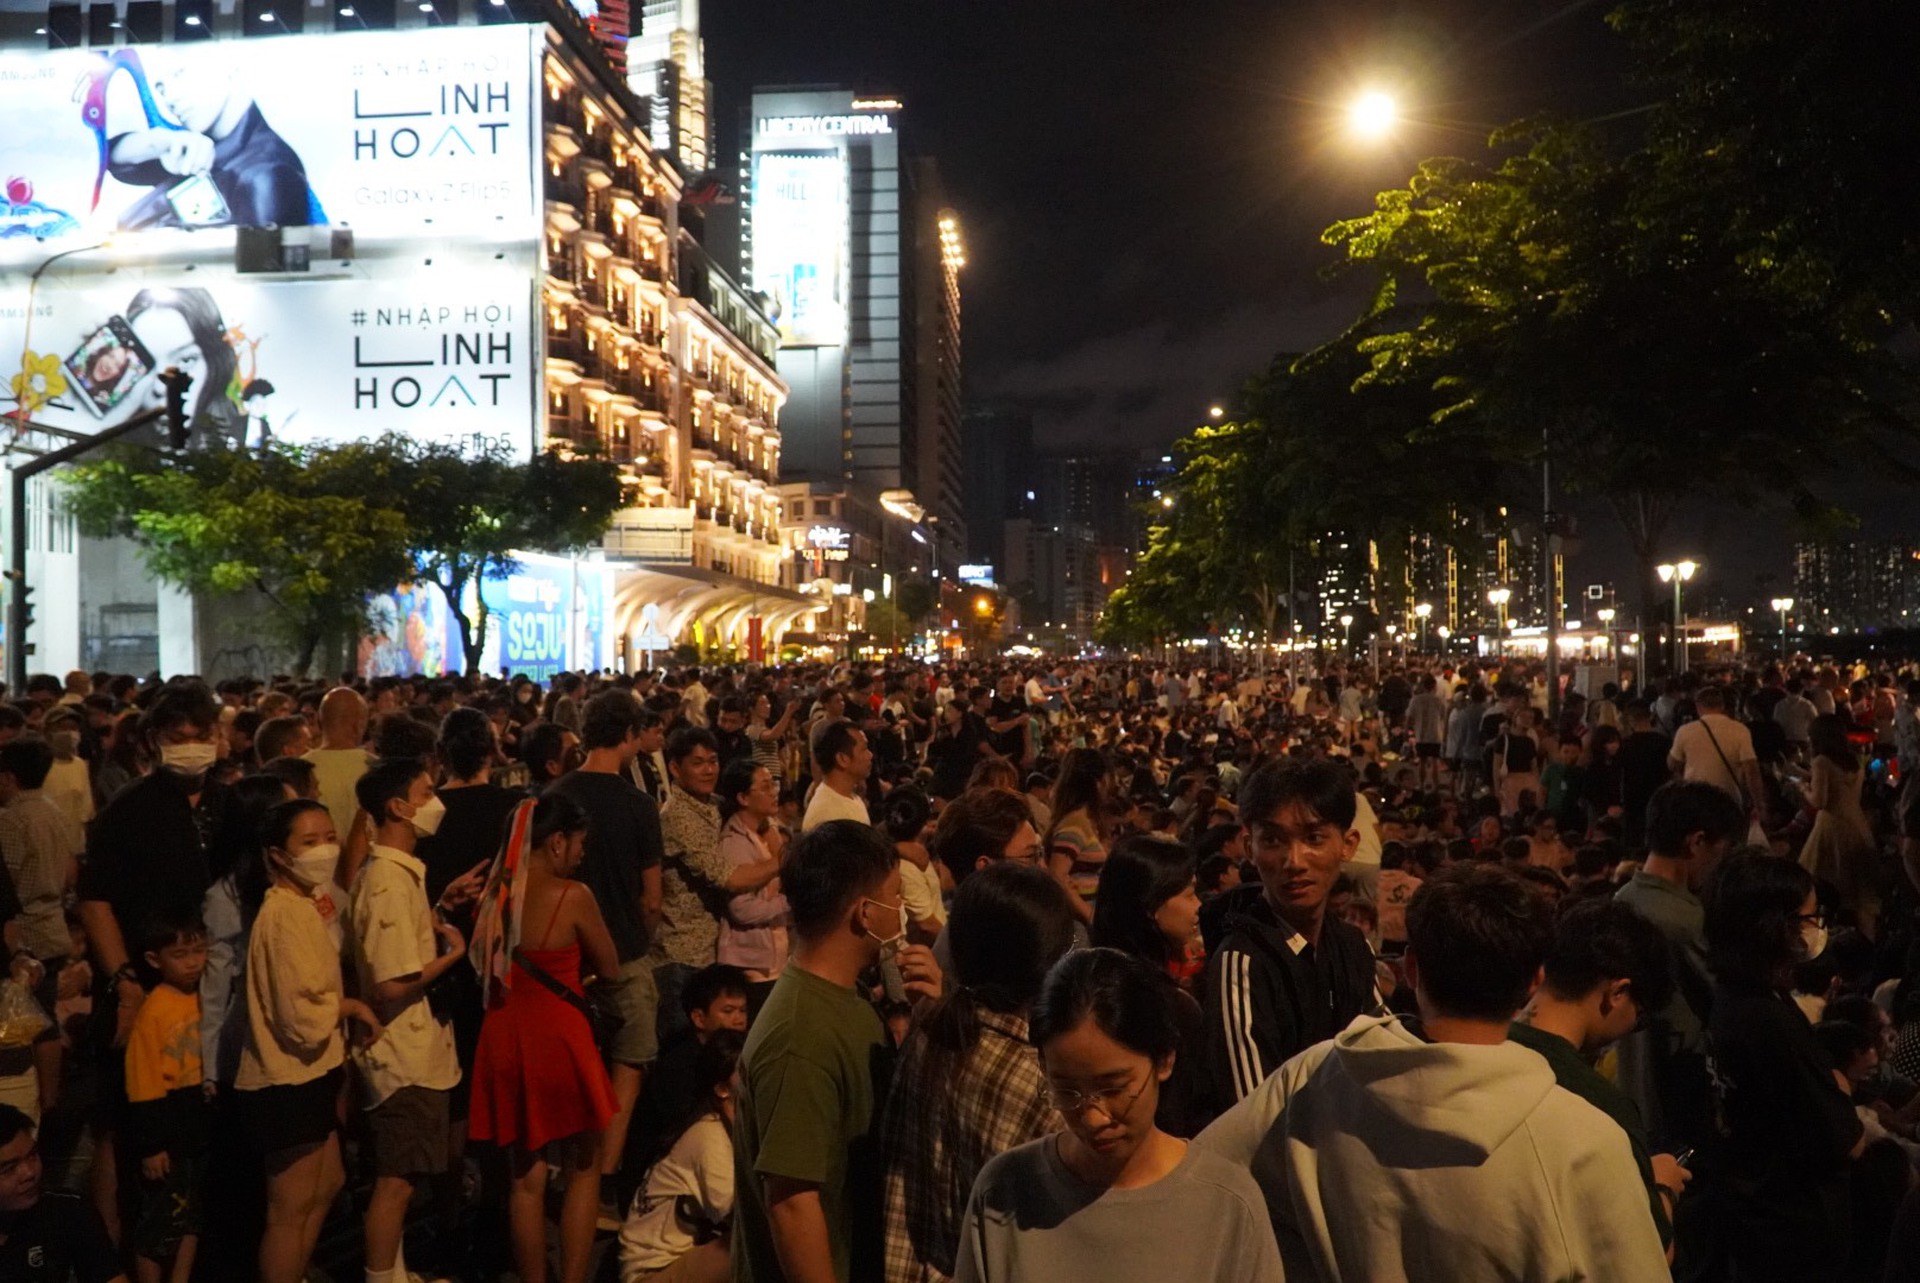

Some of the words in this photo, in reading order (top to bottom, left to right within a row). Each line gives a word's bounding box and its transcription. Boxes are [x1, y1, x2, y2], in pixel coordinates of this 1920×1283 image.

[354, 81, 510, 119] LINH
[354, 122, 510, 161] HOẠT
[821, 114, 893, 135] CENTRAL
[354, 331, 511, 368] LINH
[354, 374, 511, 410] HOẠT
[507, 610, 562, 661] SOJU
